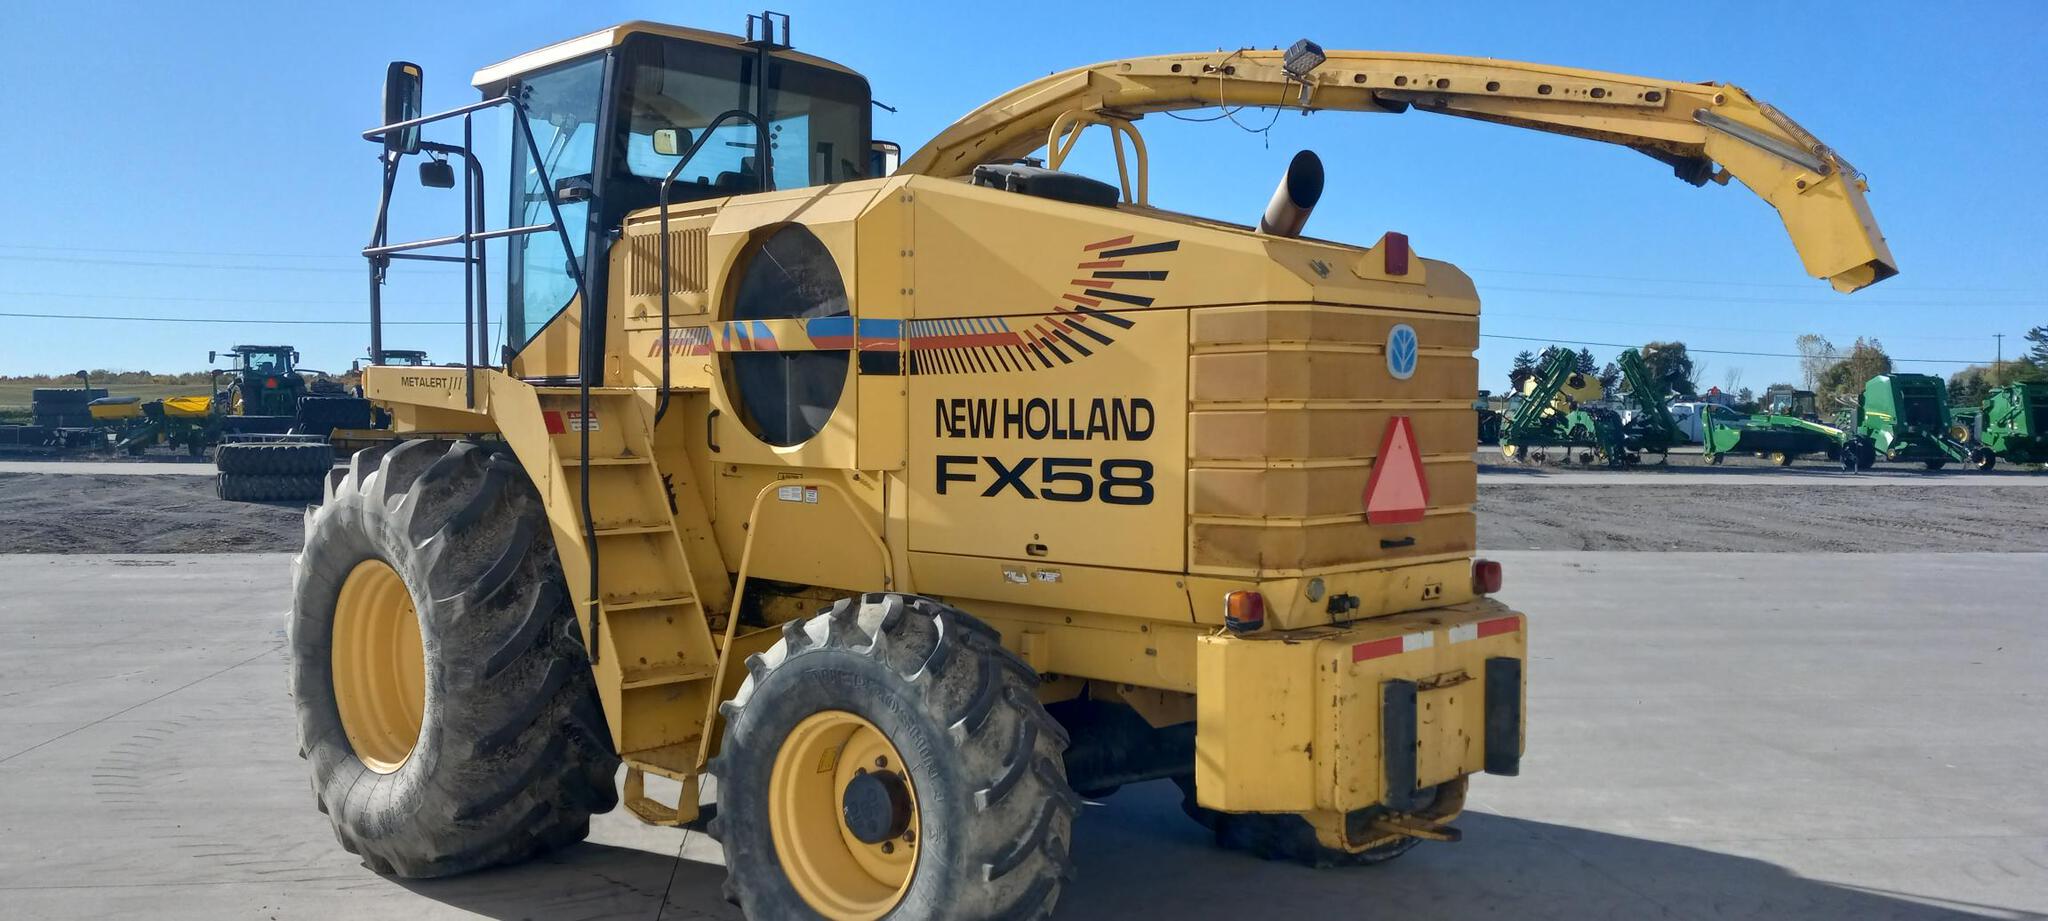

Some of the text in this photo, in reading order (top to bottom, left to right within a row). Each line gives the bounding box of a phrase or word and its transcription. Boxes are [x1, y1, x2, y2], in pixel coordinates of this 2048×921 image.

[401, 376, 447, 389] METALERT
[935, 397, 1155, 441] NEW HOLLAND
[935, 455, 1155, 506] FX58
